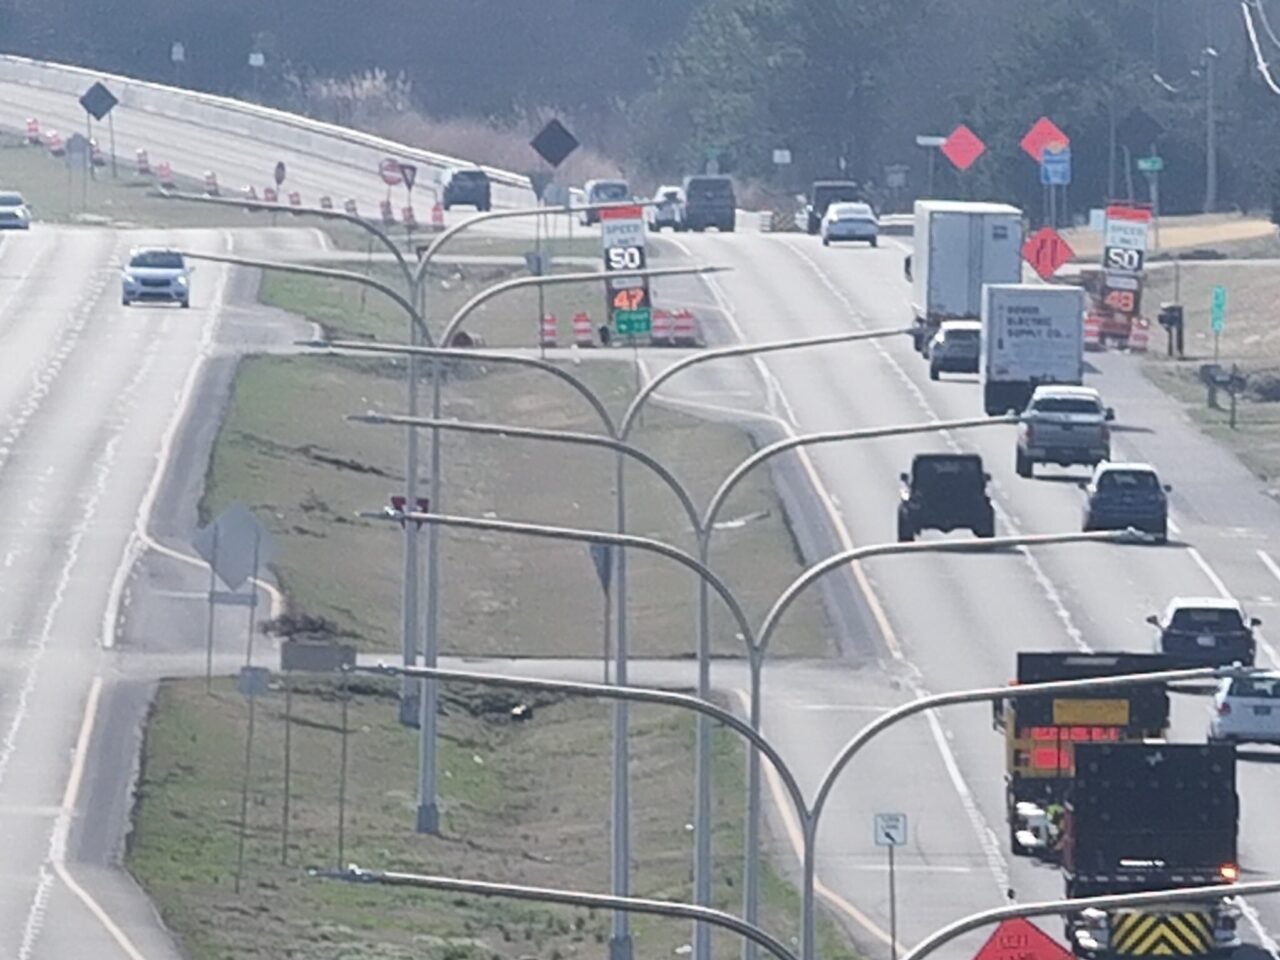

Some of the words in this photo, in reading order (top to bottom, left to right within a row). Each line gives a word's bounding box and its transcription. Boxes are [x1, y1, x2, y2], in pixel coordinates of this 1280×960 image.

[608, 247, 641, 269] 50
[1108, 248, 1140, 271] 50
[612, 288, 645, 311] 47
